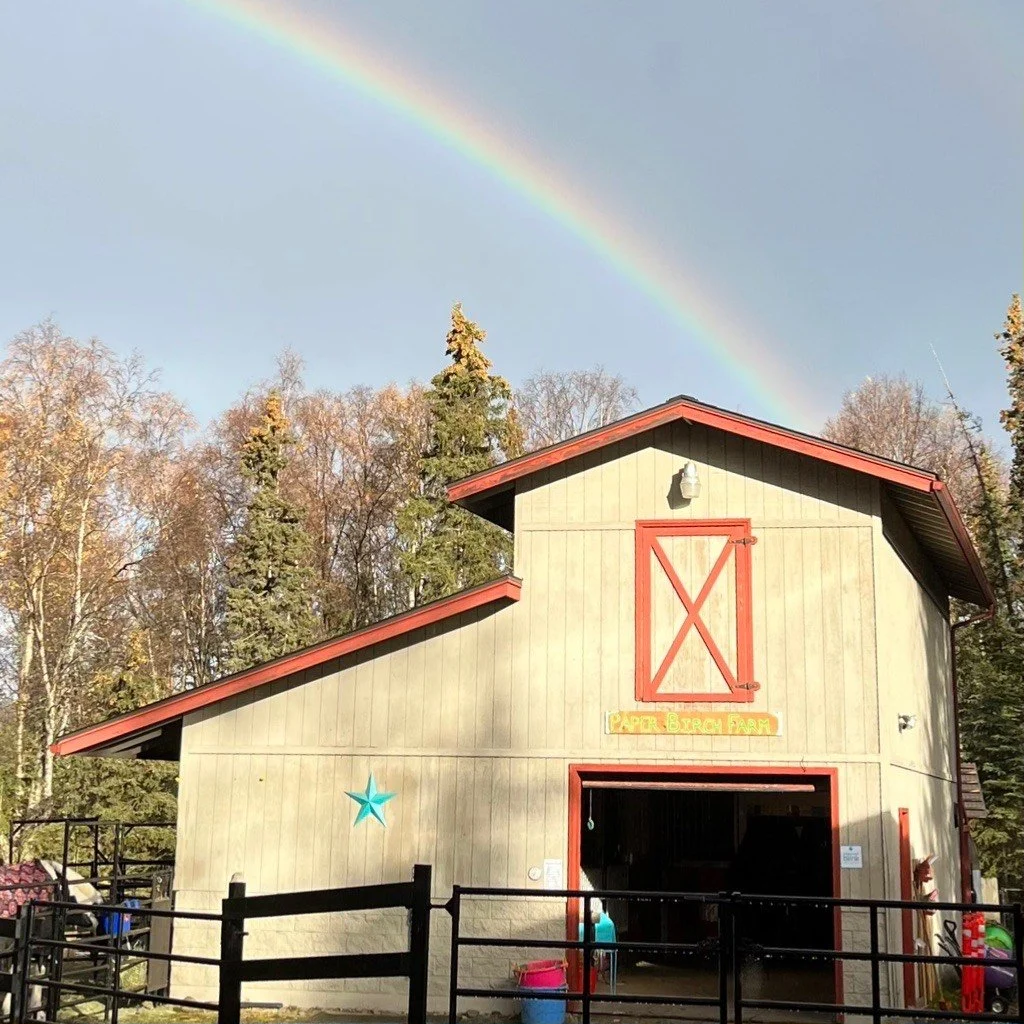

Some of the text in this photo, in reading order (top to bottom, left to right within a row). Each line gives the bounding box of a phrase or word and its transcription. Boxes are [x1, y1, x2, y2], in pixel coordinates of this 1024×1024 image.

[609, 712, 771, 735] PAPER BIRCH FARM
